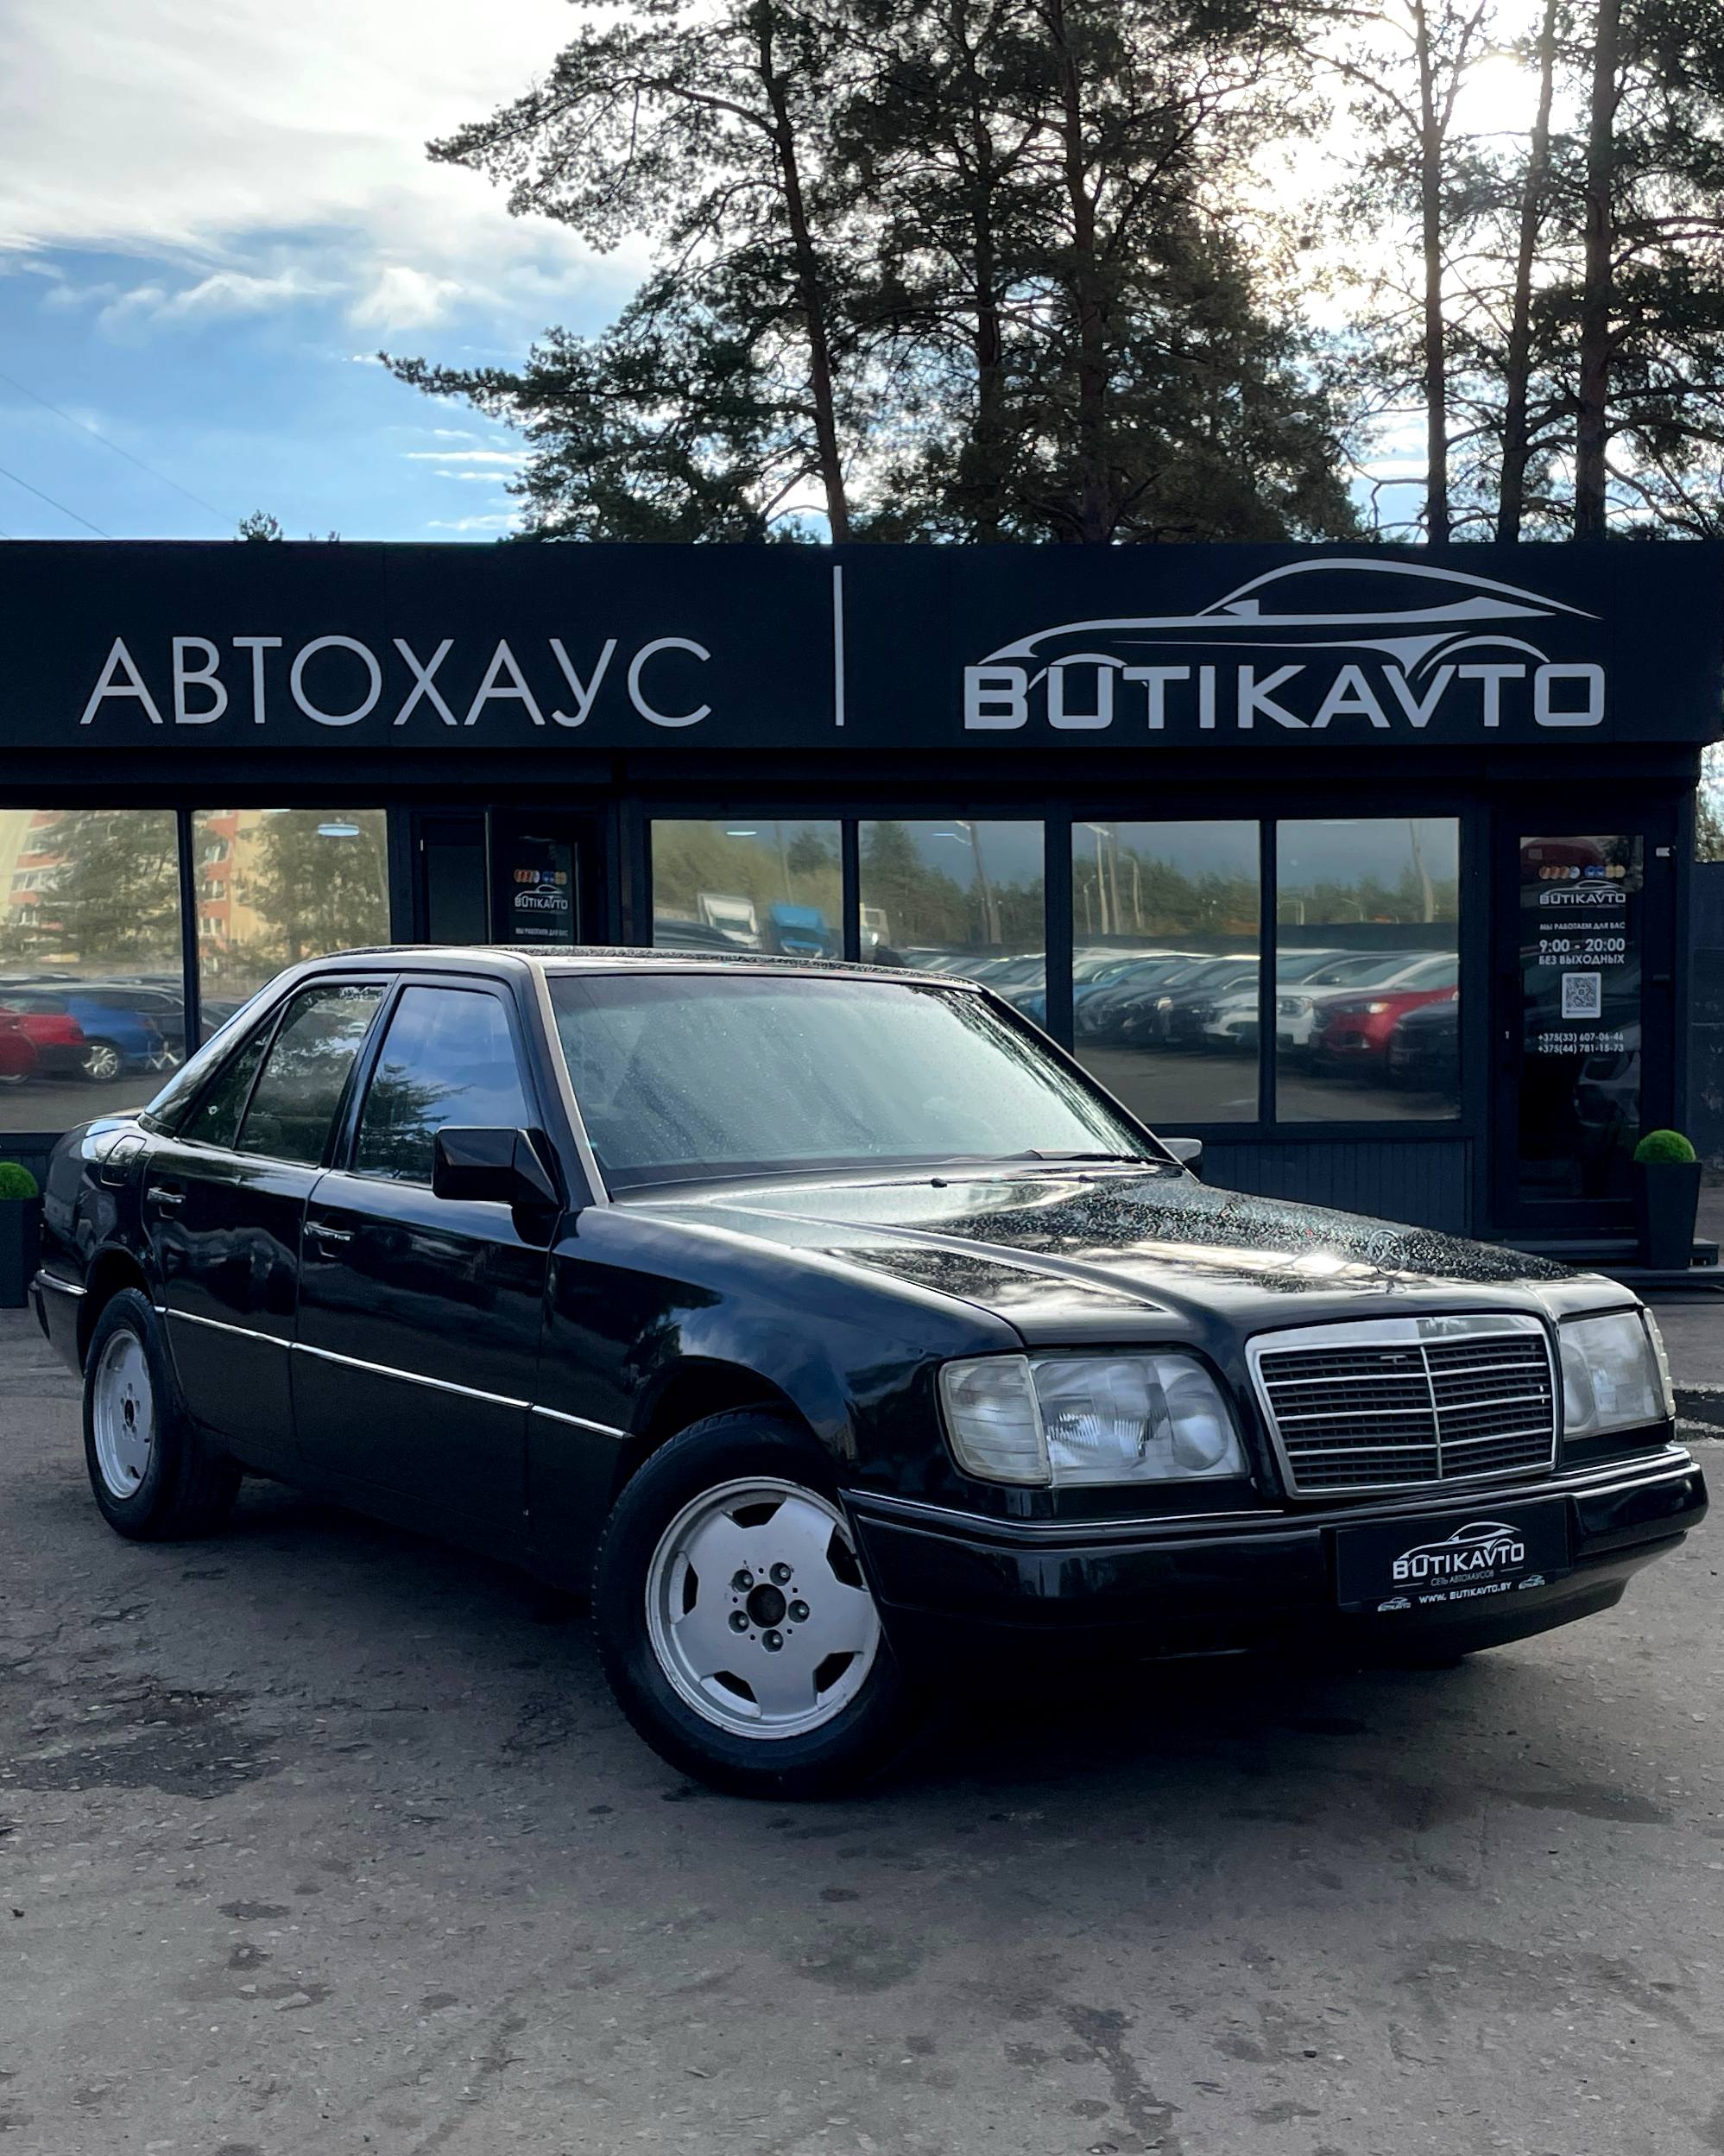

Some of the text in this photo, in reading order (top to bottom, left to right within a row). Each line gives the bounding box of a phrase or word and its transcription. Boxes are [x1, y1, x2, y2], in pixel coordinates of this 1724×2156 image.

[80, 635, 712, 728] АВТОХАУС
[963, 663, 1606, 730] BUTIKAVTO
[515, 896, 568, 909] BUTIKAVTO
[1539, 893, 1626, 905] BUTIKAVTO
[1539, 939, 1570, 952] 9:00
[1585, 938, 1626, 952] 20:00
[1538, 954, 1625, 965] БЕЗ ВЫХОДНЫХ
[1538, 1033, 1577, 1043] +375(33)
[1538, 1044, 1624, 1054] +375(44) 781-15-73
[1392, 1542, 1525, 1580] BUTIKAVTO
